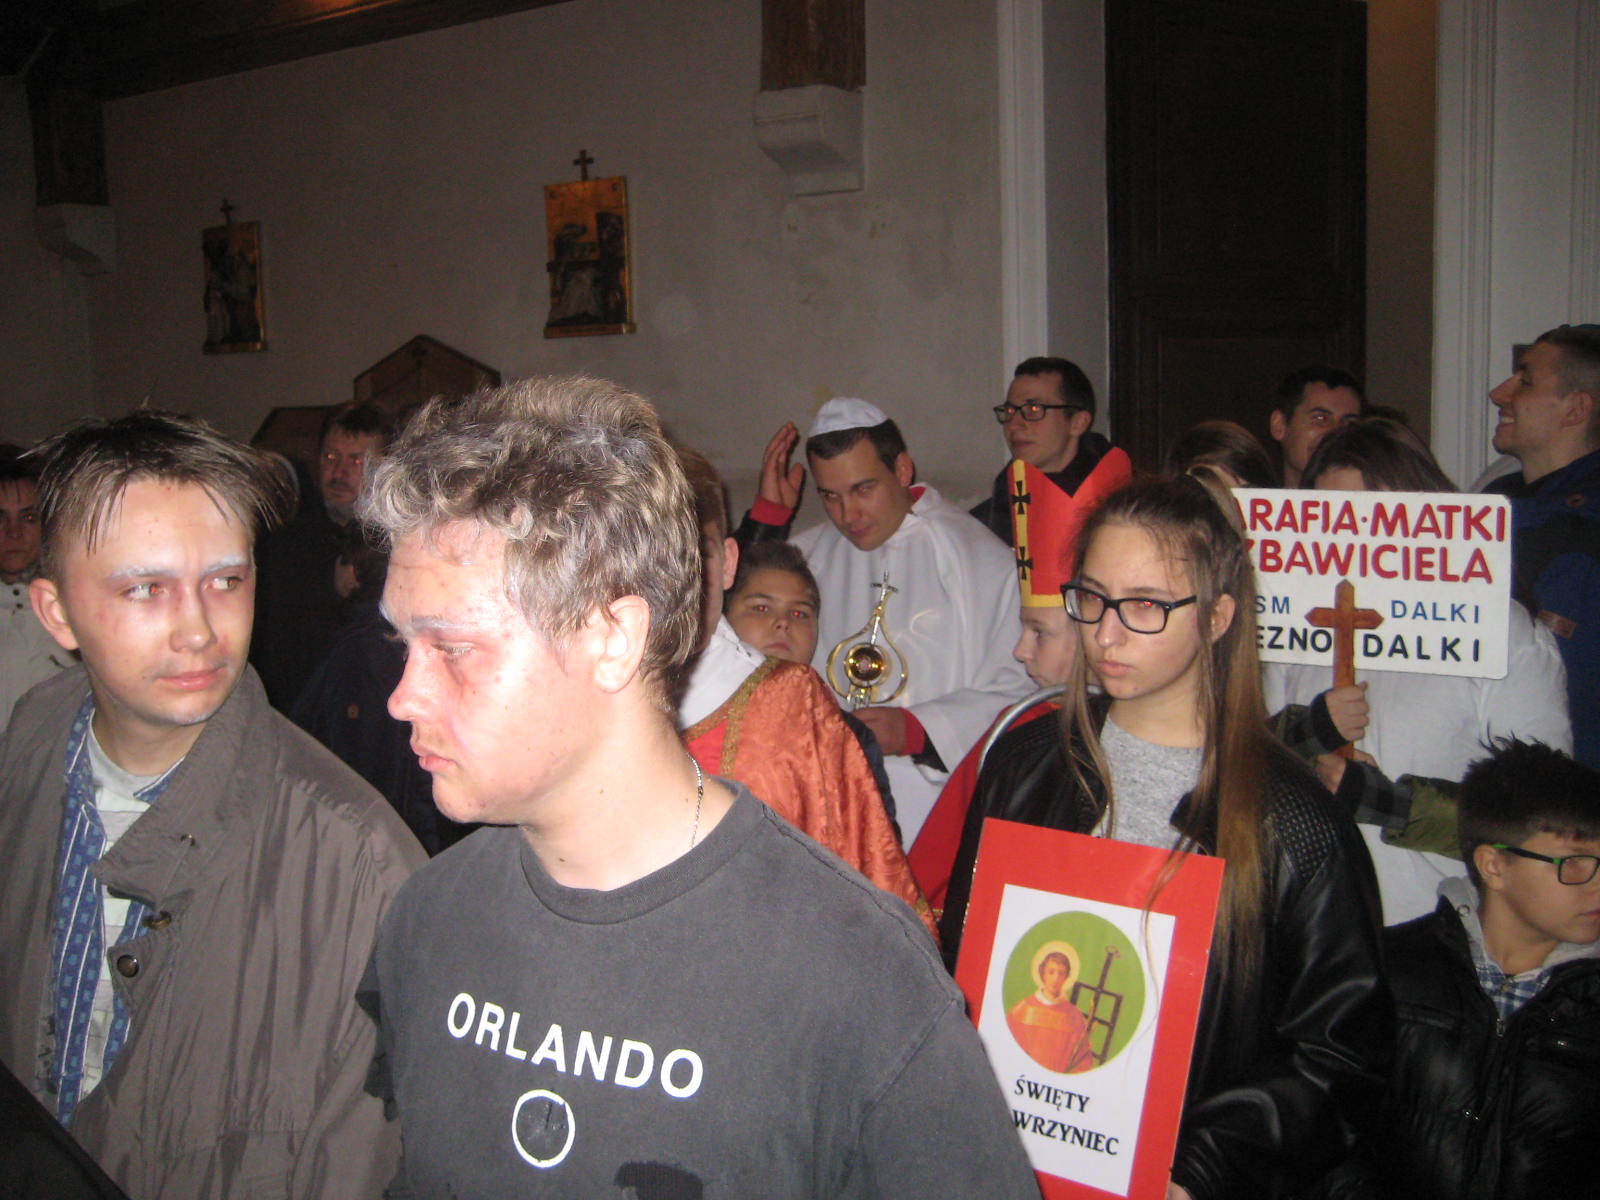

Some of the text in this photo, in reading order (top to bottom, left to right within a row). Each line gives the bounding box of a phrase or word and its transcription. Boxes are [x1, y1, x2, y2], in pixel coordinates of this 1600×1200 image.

[1391, 600, 1480, 624] DALKI
[1362, 634, 1480, 662] DALKI
[447, 992, 704, 1099] ORLANDO
[1014, 1074, 1091, 1113] ŚWIĘTY
[1012, 1108, 1120, 1156] WRZYNIEC
